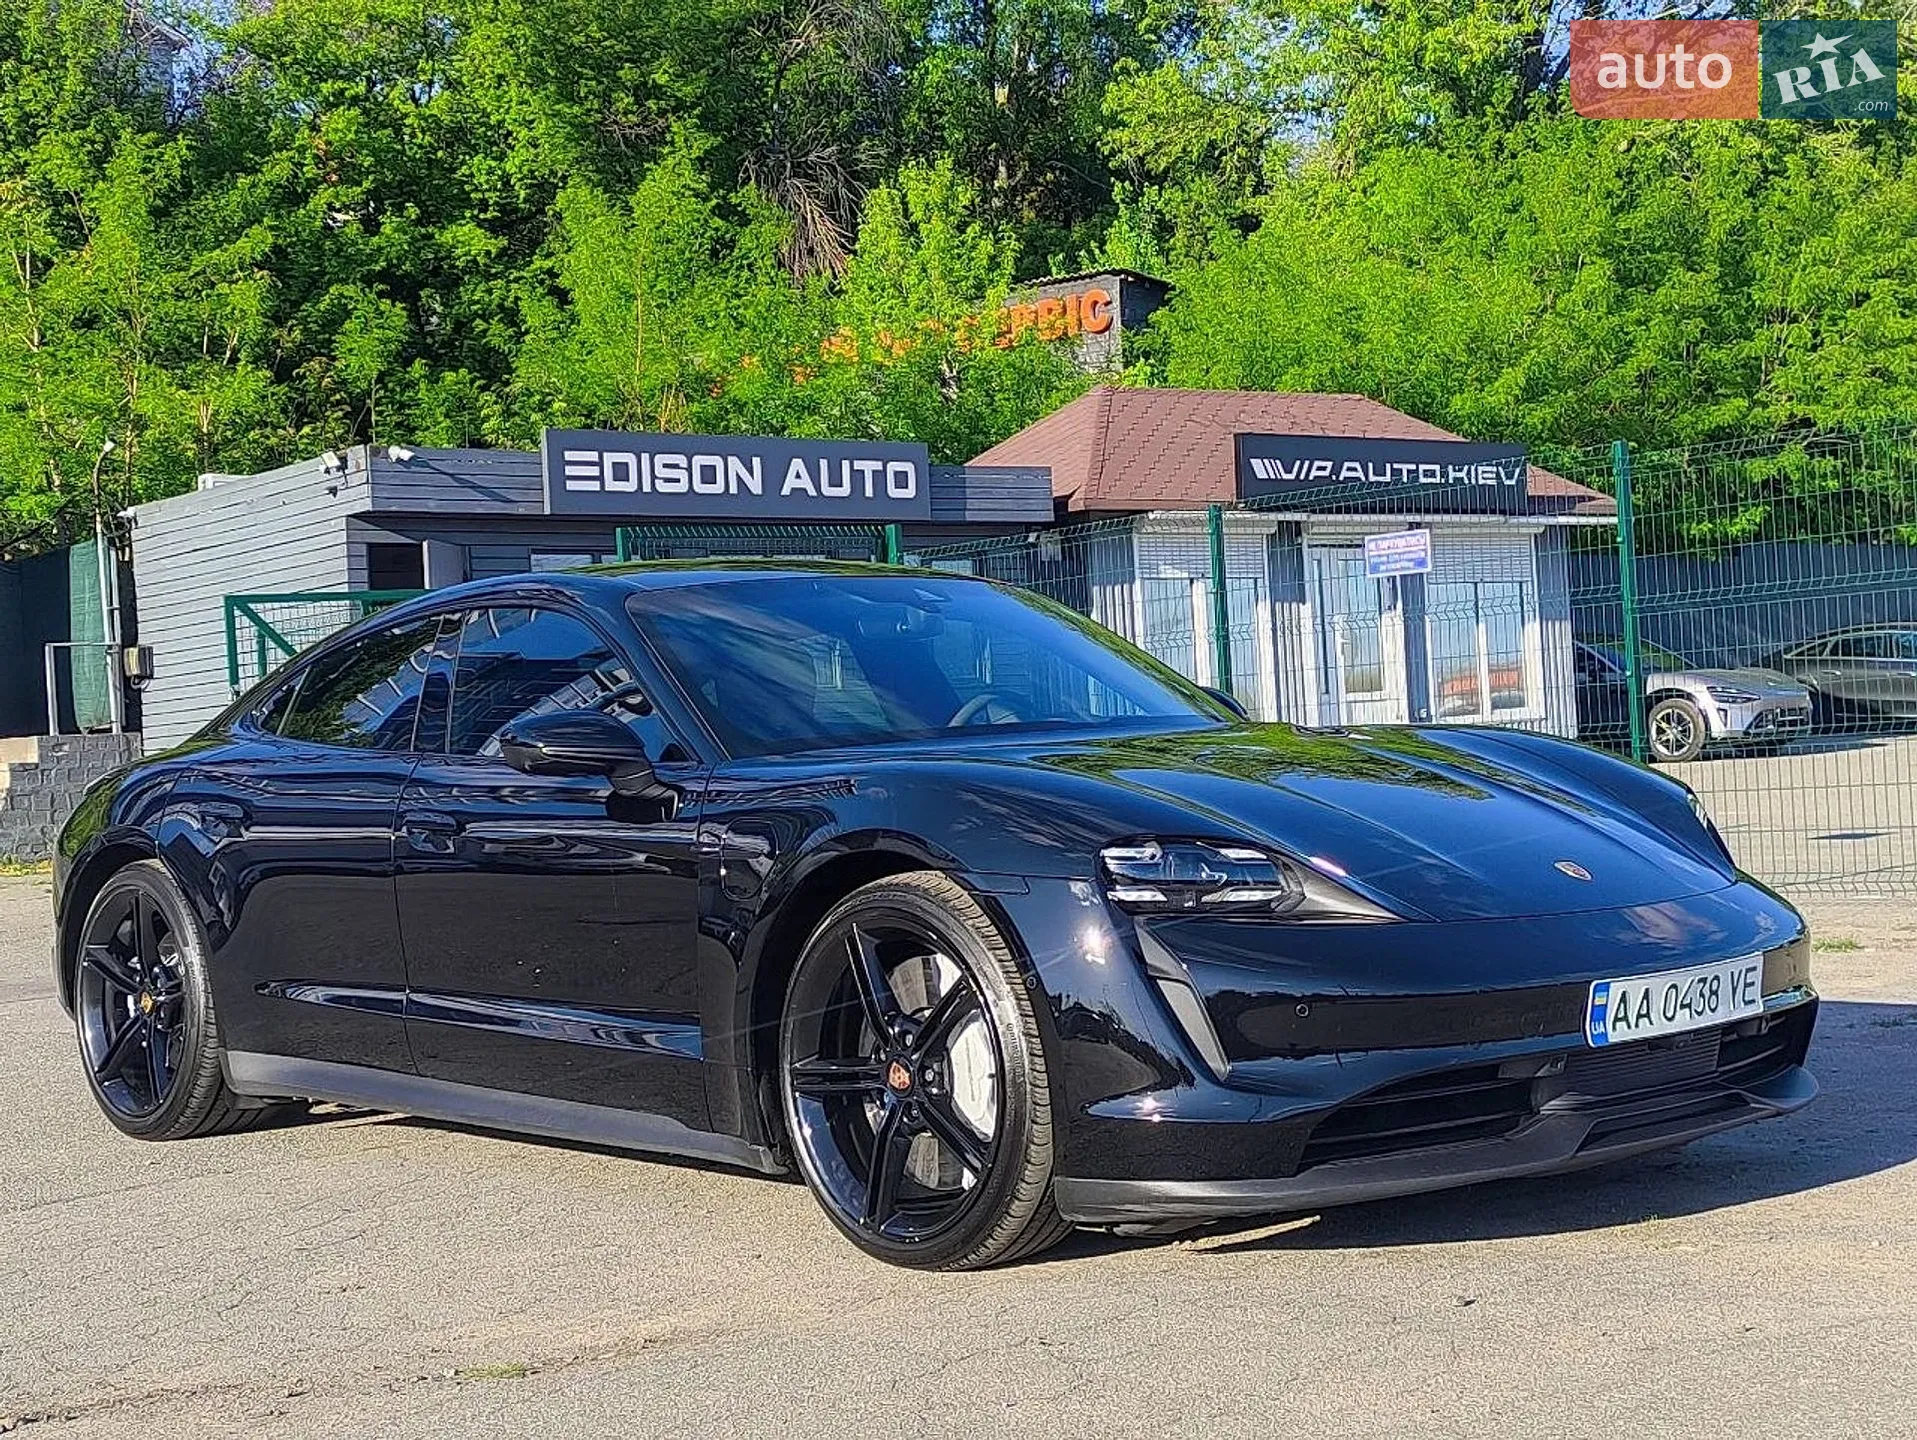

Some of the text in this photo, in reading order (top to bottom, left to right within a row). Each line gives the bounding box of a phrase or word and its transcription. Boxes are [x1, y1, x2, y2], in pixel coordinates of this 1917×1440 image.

[563, 449, 917, 499] EDISON AUTO
[1612, 967, 1757, 1032] AA 0438 VE
[1591, 1020, 1606, 1035] UA
